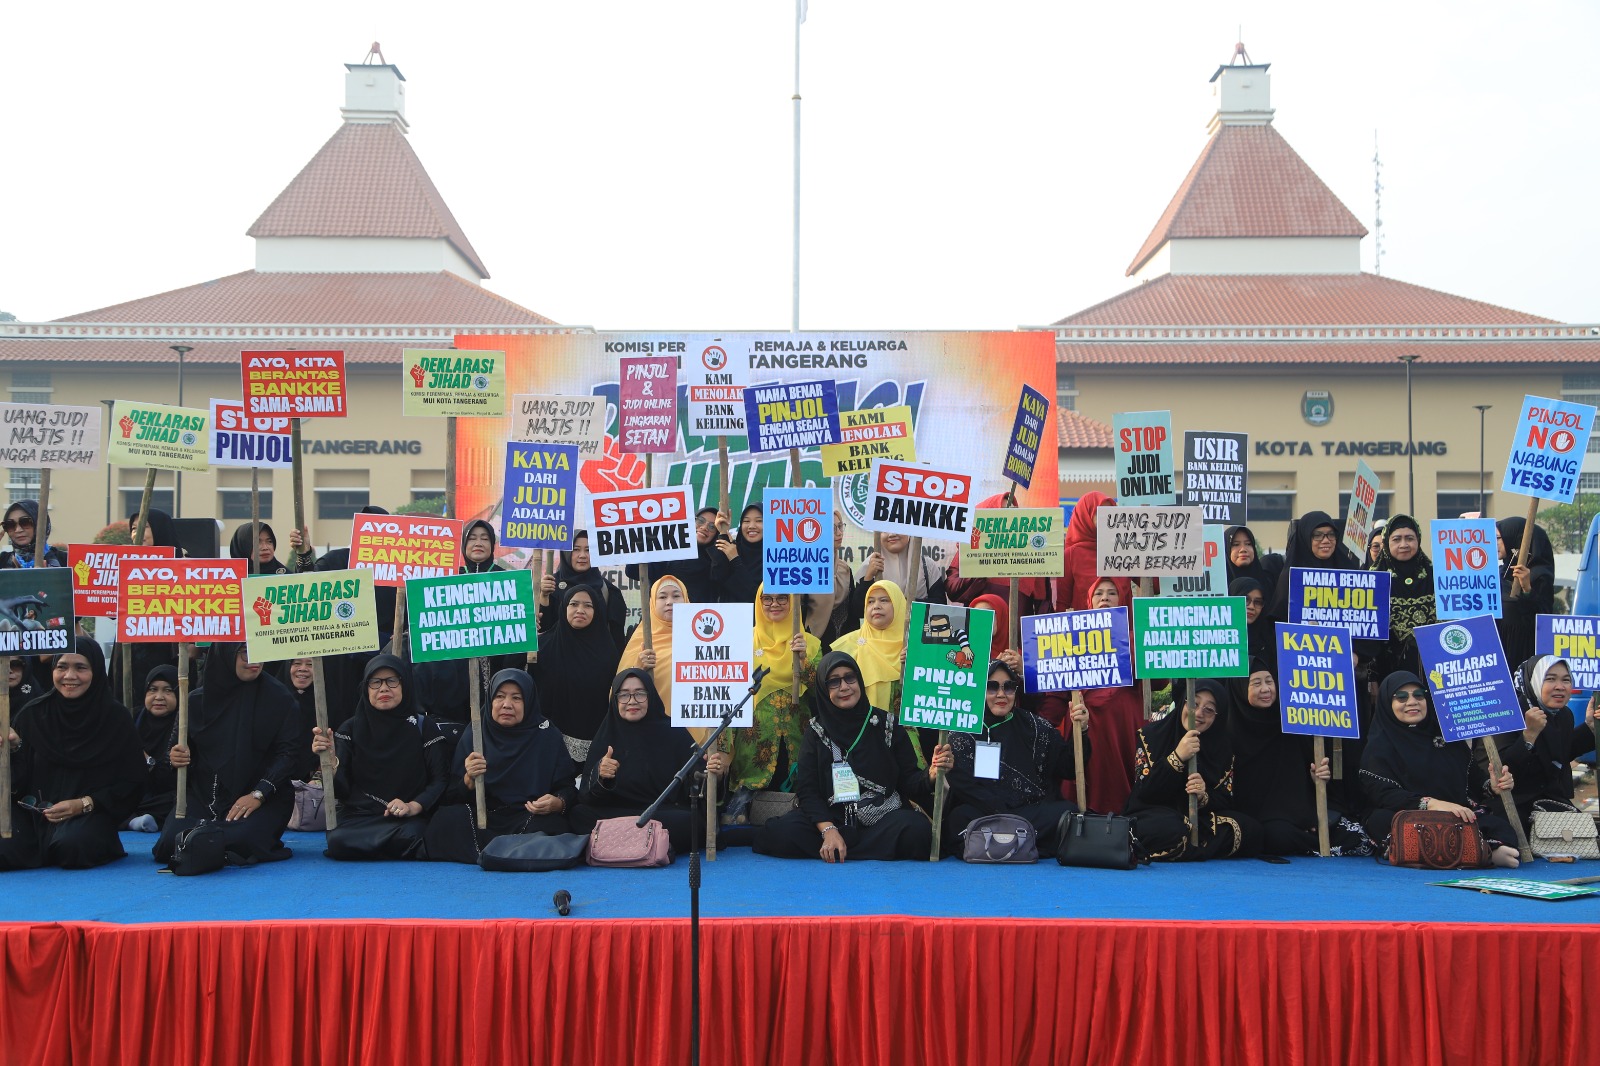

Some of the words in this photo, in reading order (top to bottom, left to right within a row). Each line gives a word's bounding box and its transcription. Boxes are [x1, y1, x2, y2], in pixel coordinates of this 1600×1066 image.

[604, 341, 654, 353] KOMISI
[754, 341, 813, 352] REMAJA
[830, 341, 908, 351] KELUARGA
[248, 357, 290, 370] AYO,
[294, 357, 337, 367] KITA
[420, 357, 495, 374] DEKLARASI
[626, 363, 669, 380] PINJOL
[249, 371, 340, 380] BERANTAS
[428, 373, 472, 389] JIHAD
[705, 373, 733, 385] KAMI
[250, 382, 341, 395] BANKKE
[641, 380, 653, 397] &
[694, 388, 744, 400] MENOLAK
[755, 387, 787, 404] MAHA
[789, 383, 823, 399] BENAR
[250, 396, 336, 413] SAMA-SAMA
[521, 400, 559, 416] UANG
[559, 401, 595, 416] JUDI
[622, 399, 642, 410] JUDI
[644, 398, 672, 409] ONLINE
[705, 404, 734, 416] BANK
[758, 398, 829, 424] PINJOL
[1022, 392, 1045, 421] KAYA
[3, 409, 47, 426] UANG
[48, 411, 89, 428] JUDI
[130, 409, 205, 431] DEKLARASI
[220, 409, 289, 431] STOP
[624, 415, 672, 427] LINGKARAN
[695, 417, 744, 430] KELILING
[759, 422, 794, 437] DENGAN
[796, 417, 830, 432] SEGALA
[847, 411, 885, 427] KAMI
[1024, 414, 1038, 431] DARI
[1528, 406, 1584, 431] PINJOL
[10, 427, 65, 446] NAJIS
[136, 426, 180, 443] JIHAD
[526, 419, 573, 437] NAJIS
[624, 428, 669, 447] SETAN
[760, 430, 833, 451] RAYUANNYA
[1016, 426, 1039, 451] JUDI
[1119, 426, 1167, 453] STOP
[216, 432, 292, 462] PINJOL
[301, 440, 422, 455] TANGERANG
[849, 441, 890, 457] BANK
[1193, 437, 1239, 462] USIR
[1255, 441, 1313, 456] KOTA
[1321, 441, 1447, 456] TANGERANG
[40, 449, 94, 465] BERKAH
[512, 450, 570, 471] KAYA
[1127, 453, 1161, 475] JUDI
[1512, 450, 1578, 476] NABUNG
[1187, 461, 1208, 471] BANK
[1210, 462, 1244, 473] KELILING
[524, 472, 557, 485] DARI
[883, 470, 965, 499] STOP
[1120, 474, 1173, 497] ONLINE
[1187, 473, 1242, 491] BANKKE
[1510, 467, 1555, 492] YESS
[513, 486, 567, 507] JUDI
[1187, 491, 1199, 502] DI
[1202, 491, 1242, 504] WILAYAH
[511, 507, 566, 521] ADALAH
[600, 497, 681, 524] STOP
[770, 499, 826, 515] PINJOL
[872, 495, 969, 533] BANKKE
[360, 521, 403, 537] AYO,
[409, 524, 454, 538] KITA
[976, 516, 1053, 533] DEKLARASI
[1107, 512, 1149, 530] UANG
[1152, 512, 1191, 530] JUDI
[506, 521, 568, 542] BOHONG
[596, 523, 691, 556] BANKKE
[1438, 529, 1490, 544] PINJOL
[359, 535, 455, 550] BERANTAS
[984, 533, 1029, 549] JIHAD
[1114, 532, 1167, 552] NAJIS
[357, 547, 455, 567] BANKKE
[766, 547, 829, 564] NABUNG
[1104, 555, 1140, 571] NGGA
[1144, 554, 1197, 570] BERKAH
[127, 567, 178, 583] AYO,
[185, 567, 238, 580] KITA
[766, 567, 813, 586] YESS
[1302, 571, 1336, 588] MAHA
[1339, 573, 1376, 588] BENAR
[1438, 574, 1497, 591] NABUNG
[127, 583, 240, 596] BERANTAS
[265, 578, 361, 605] DEKLARASI
[423, 579, 517, 609] KEINGINAN
[1303, 586, 1378, 610] PINJOL
[127, 598, 240, 615] BANKKE
[1439, 593, 1484, 612] YESS
[277, 601, 333, 625] JIHAD
[418, 608, 470, 629] ADALAH
[473, 603, 526, 621] SUMBER
[1148, 605, 1232, 628] KEINGINAN
[1301, 607, 1340, 622] DENGAN
[1342, 608, 1378, 623] SEGALA
[126, 615, 231, 637] SAMA-SAMA
[1034, 616, 1070, 635] MAHA
[1072, 612, 1113, 631] BENAR
[1551, 618, 1594, 635] MAHA
[22, 629, 68, 650] STRESS
[272, 636, 288, 645] MUI
[289, 634, 309, 643] KOTA
[311, 630, 355, 641] TANGERANG
[421, 623, 527, 652] PENDERITAAN
[1037, 629, 1117, 659] PINJOL
[1143, 630, 1190, 646] ADALAH
[1192, 629, 1240, 646] SUMBER
[1282, 631, 1343, 655] KAYA
[695, 645, 731, 660] KAMI
[1144, 648, 1240, 669] PENDERITAAN
[1297, 654, 1332, 669] DARI
[1037, 656, 1076, 674] DENGAN
[1078, 653, 1119, 671] SEGALA
[1435, 653, 1498, 675] DEKLARASI
[680, 665, 745, 681] MENOLAK
[912, 666, 977, 688] PINJOL
[1037, 667, 1122, 691] RAYUANNYA
[1289, 668, 1345, 692] JUDI
[1446, 669, 1482, 687] JIHAD
[693, 686, 731, 701] BANK
[1289, 692, 1346, 707] ADALAH
[913, 694, 972, 712] MALING
[904, 707, 953, 727] LEWAT
[956, 713, 979, 729] HP
[1286, 706, 1352, 729] BOHONG
